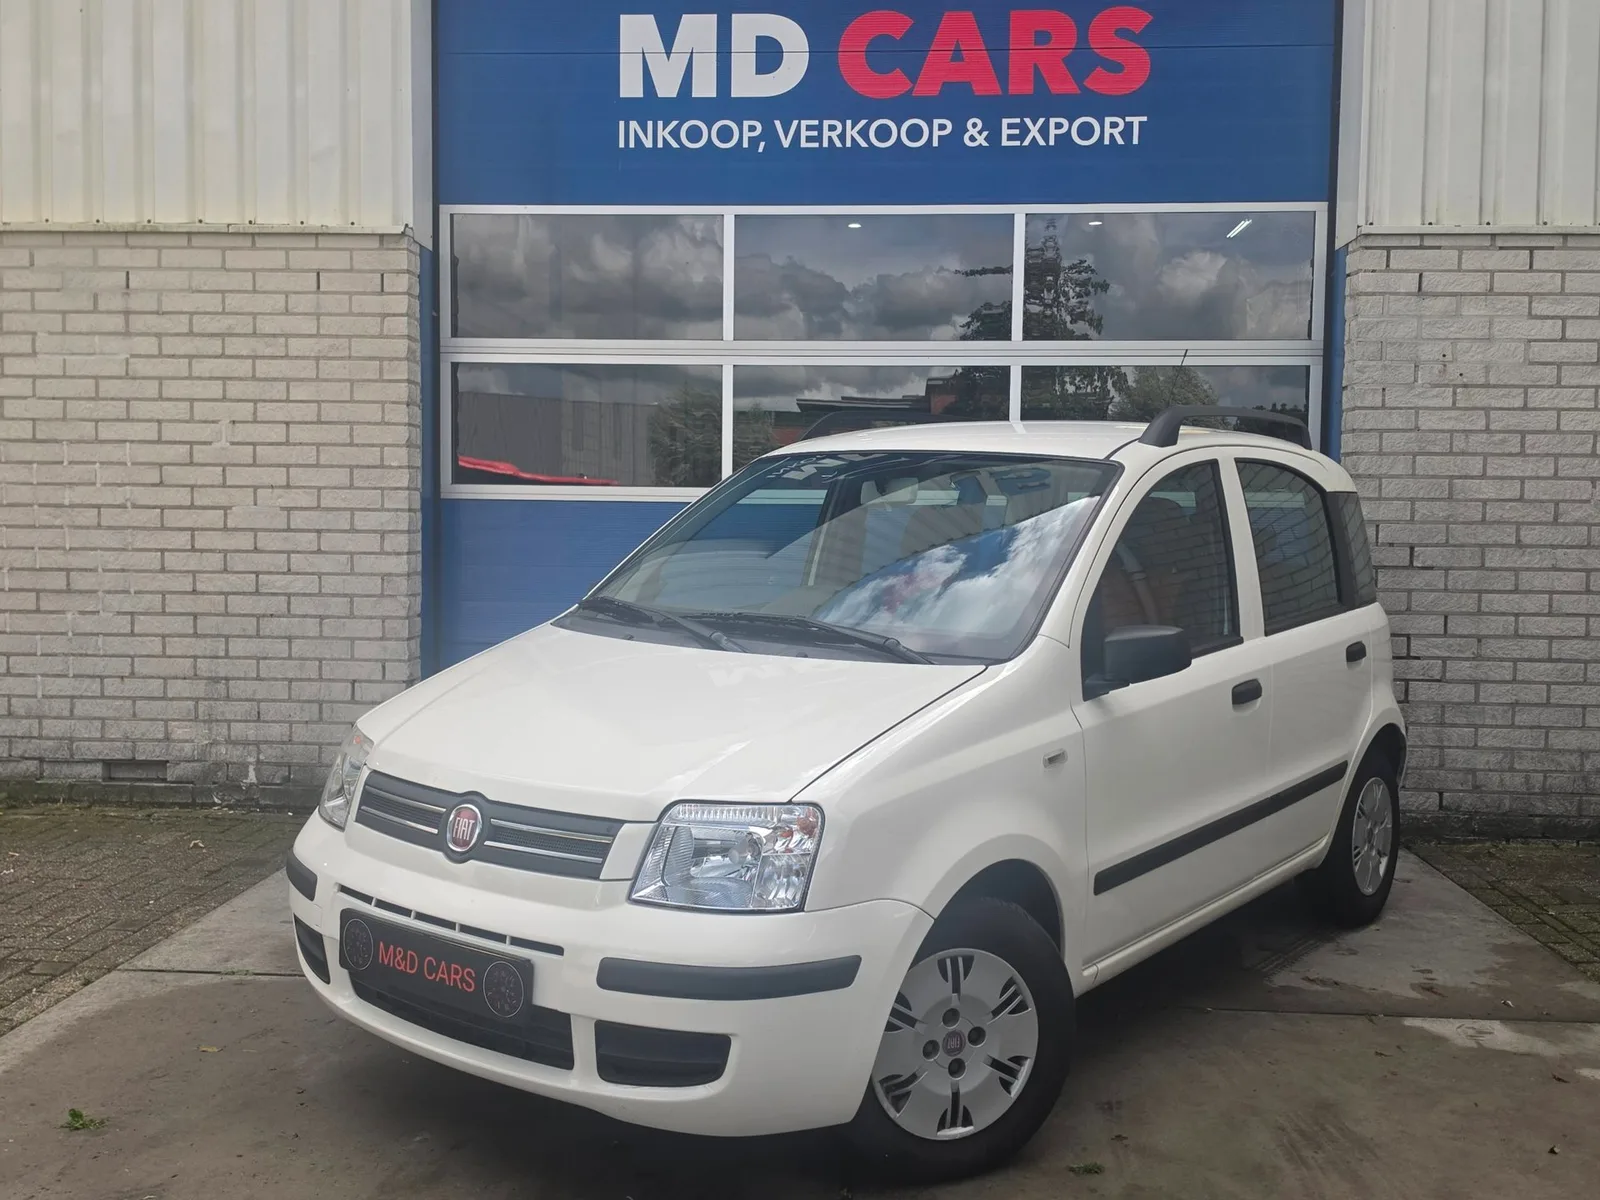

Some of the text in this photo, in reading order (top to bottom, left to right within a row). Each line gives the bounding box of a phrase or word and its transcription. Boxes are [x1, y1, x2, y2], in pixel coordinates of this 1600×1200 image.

[619, 7, 1153, 99] MD CARS
[618, 116, 1148, 152] INKOOP, VERKOOP & EXPORT
[452, 817, 476, 841] FIAT
[378, 941, 476, 992] M&D CARS
